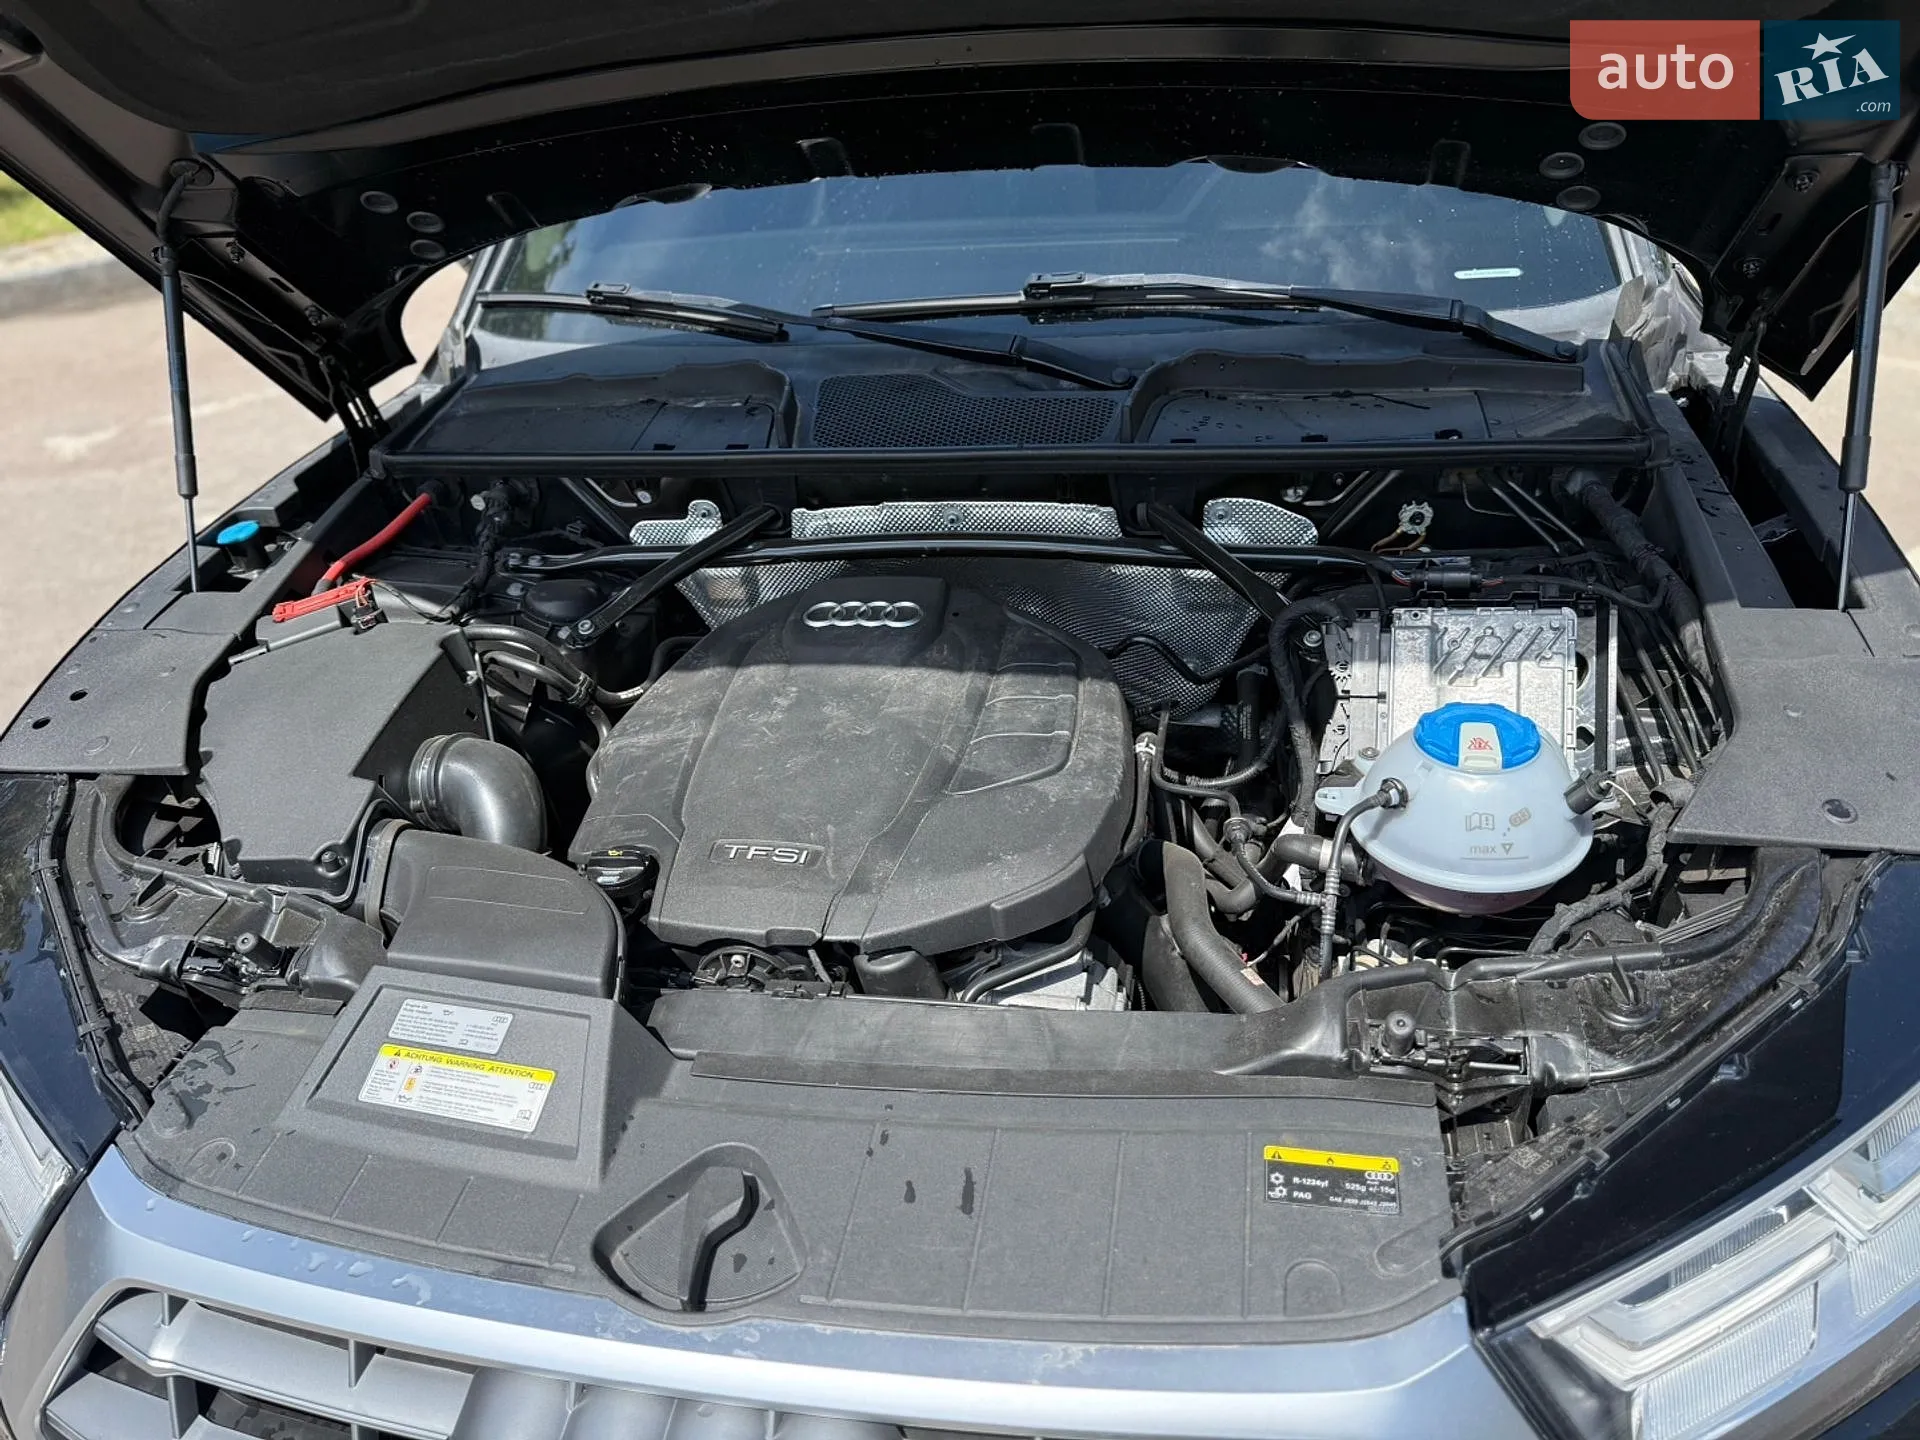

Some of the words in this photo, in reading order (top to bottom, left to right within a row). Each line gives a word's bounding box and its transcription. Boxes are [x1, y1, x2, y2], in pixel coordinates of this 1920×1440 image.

[724, 843, 808, 865] TFSI
[1470, 845, 1497, 854] max
[404, 1051, 443, 1064] ACHTUNG
[446, 1058, 485, 1071] WARNING
[487, 1065, 535, 1079] ATTENTION
